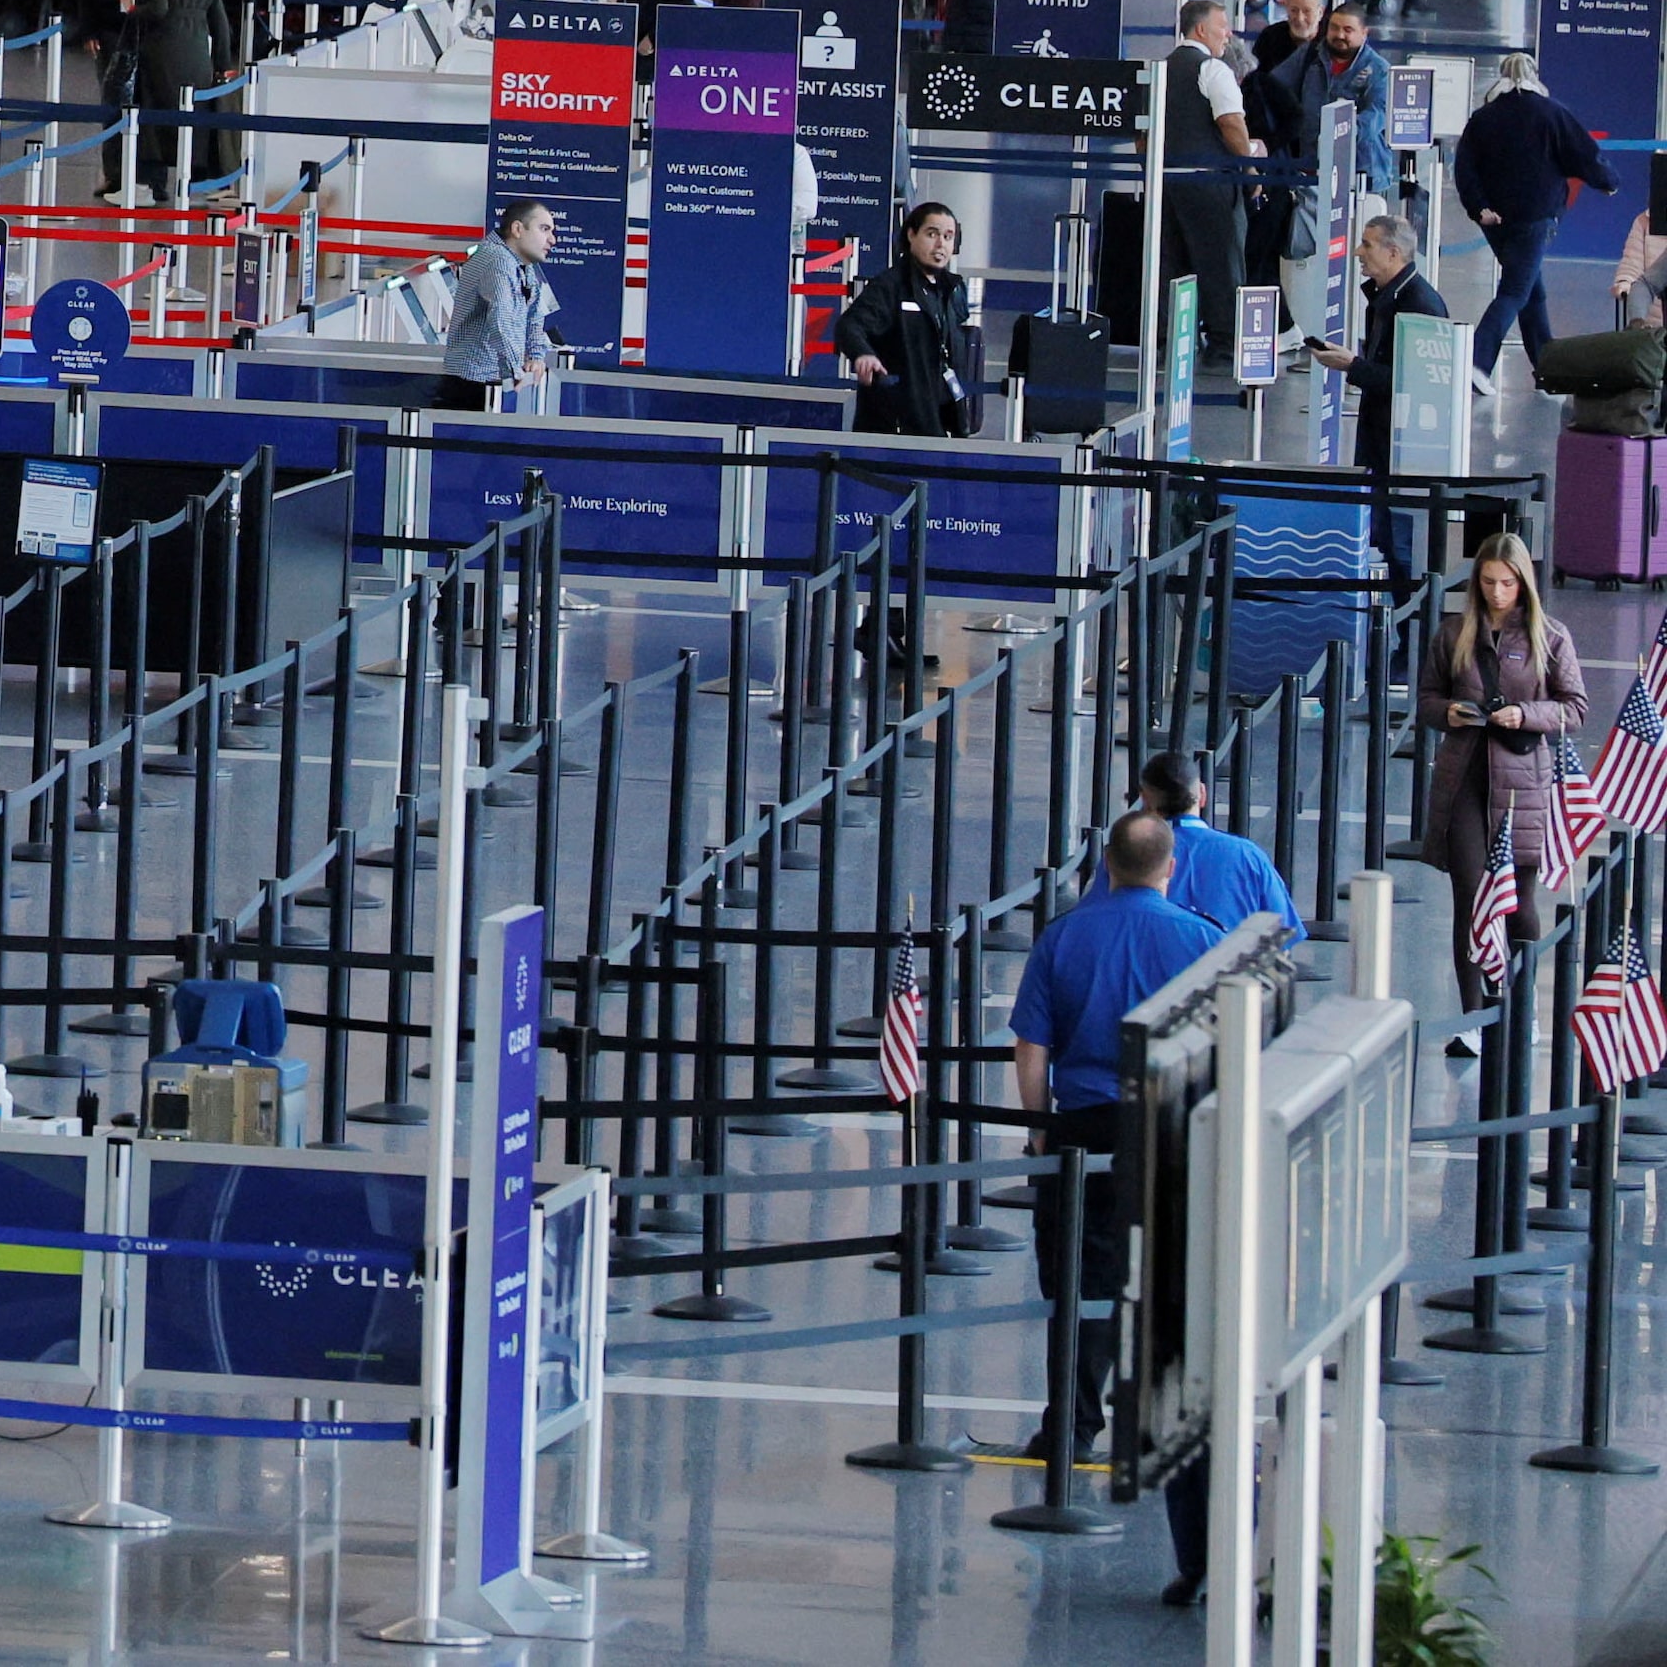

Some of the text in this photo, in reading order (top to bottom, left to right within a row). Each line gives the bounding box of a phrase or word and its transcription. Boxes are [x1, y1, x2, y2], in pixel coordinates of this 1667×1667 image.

[1578, 0, 1594, 10] App
[1630, 1, 1648, 11] Pass
[532, 14, 602, 31] DELTA
[1577, 24, 1626, 37] Identification
[687, 66, 738, 78] DELTA
[501, 72, 551, 91] SKY
[830, 82, 886, 98] ASSIST
[500, 90, 615, 113] PRIORITY
[700, 85, 780, 117] ONE
[1000, 83, 1123, 112] CLEAR
[1083, 114, 1123, 127] PLUS
[498, 133, 517, 142] Delta
[497, 146, 527, 155] Premium
[529, 148, 548, 156] Select
[530, 161, 559, 170] Platinum
[567, 163, 583, 171] Gold
[667, 163, 685, 174] WE
[823, 171, 882, 183] Specialty Items
[666, 184, 754, 197] Delta One Customers
[851, 196, 879, 206] Minors
[665, 203, 755, 216] Delta Members
[822, 218, 839, 227] Pets
[243, 259, 258, 274] EXIT
[68, 301, 95, 309] CLEAR
[485, 491, 512, 505] Less
[570, 496, 602, 510] More
[606, 498, 667, 516] Exploring
[946, 518, 1001, 536] Enjoying
[135, 1242, 168, 1251] CLEAR
[133, 1417, 166, 1426] CLEAR
[321, 1427, 353, 1435] CLEAR
